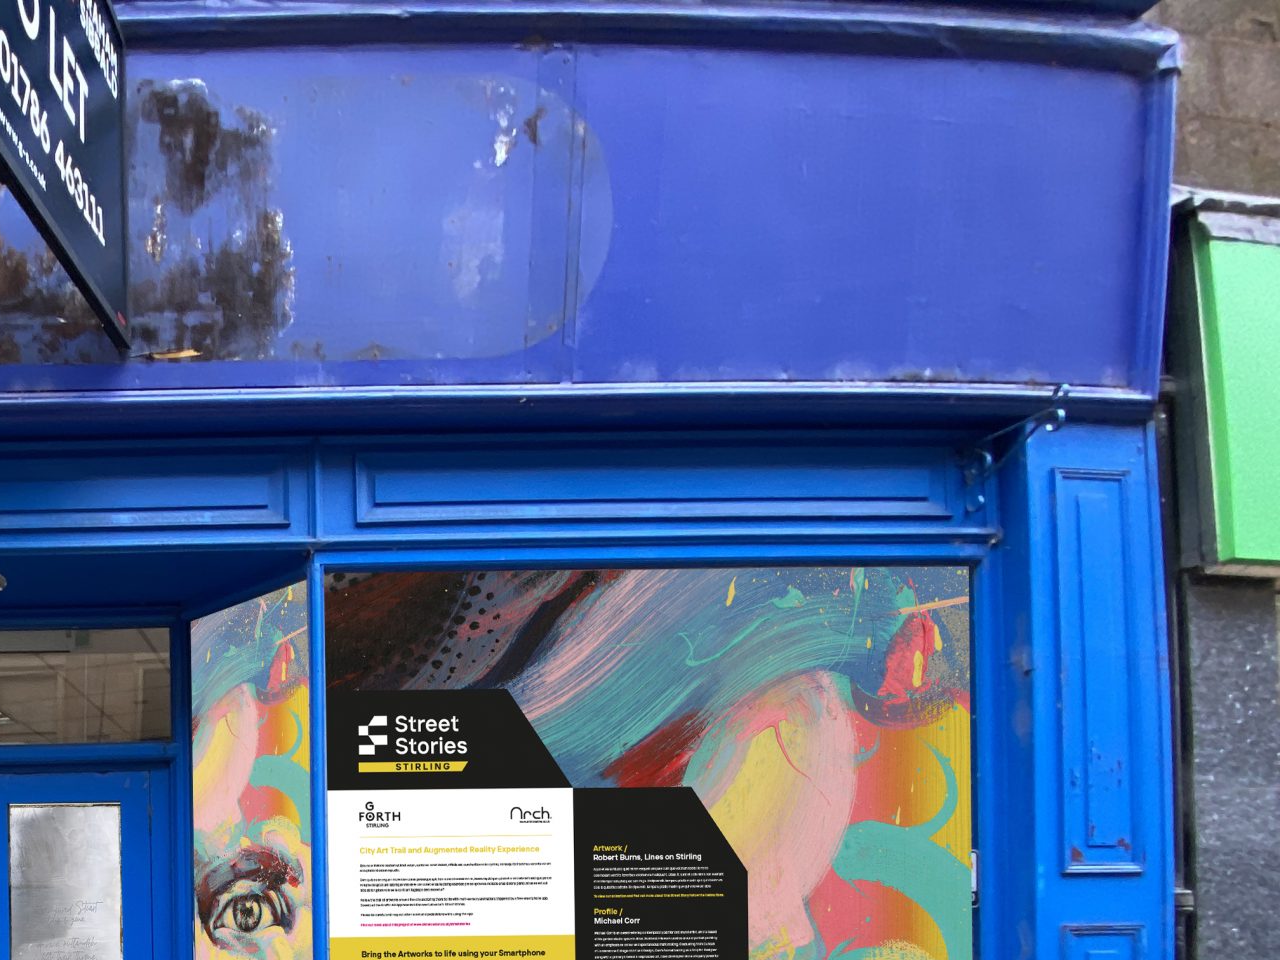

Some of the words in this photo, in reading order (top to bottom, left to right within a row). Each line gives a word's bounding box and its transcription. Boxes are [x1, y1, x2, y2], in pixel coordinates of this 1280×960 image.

[49, 6, 89, 144] LET
[54, 140, 105, 247] 463111
[395, 715, 459, 733] Street
[395, 736, 468, 755] Stories
[395, 762, 451, 771] STIRLING
[365, 801, 375, 811] G
[359, 811, 401, 822] FORTH
[360, 847, 375, 855] City
[390, 846, 407, 854] Trail
[408, 846, 422, 854] and
[423, 846, 468, 855] Augmented
[469, 845, 496, 854] Reality
[497, 845, 540, 854] Experience
[593, 853, 618, 861] Robert
[620, 853, 643, 862] Burns,
[644, 852, 664, 860] Lines
[675, 852, 702, 861] Stirling
[361, 950, 382, 959] Bring
[398, 950, 433, 958] Artworks
[444, 949, 457, 957] life
[458, 949, 479, 958] using
[480, 950, 497, 958] your
[499, 949, 546, 958] Smartphone
